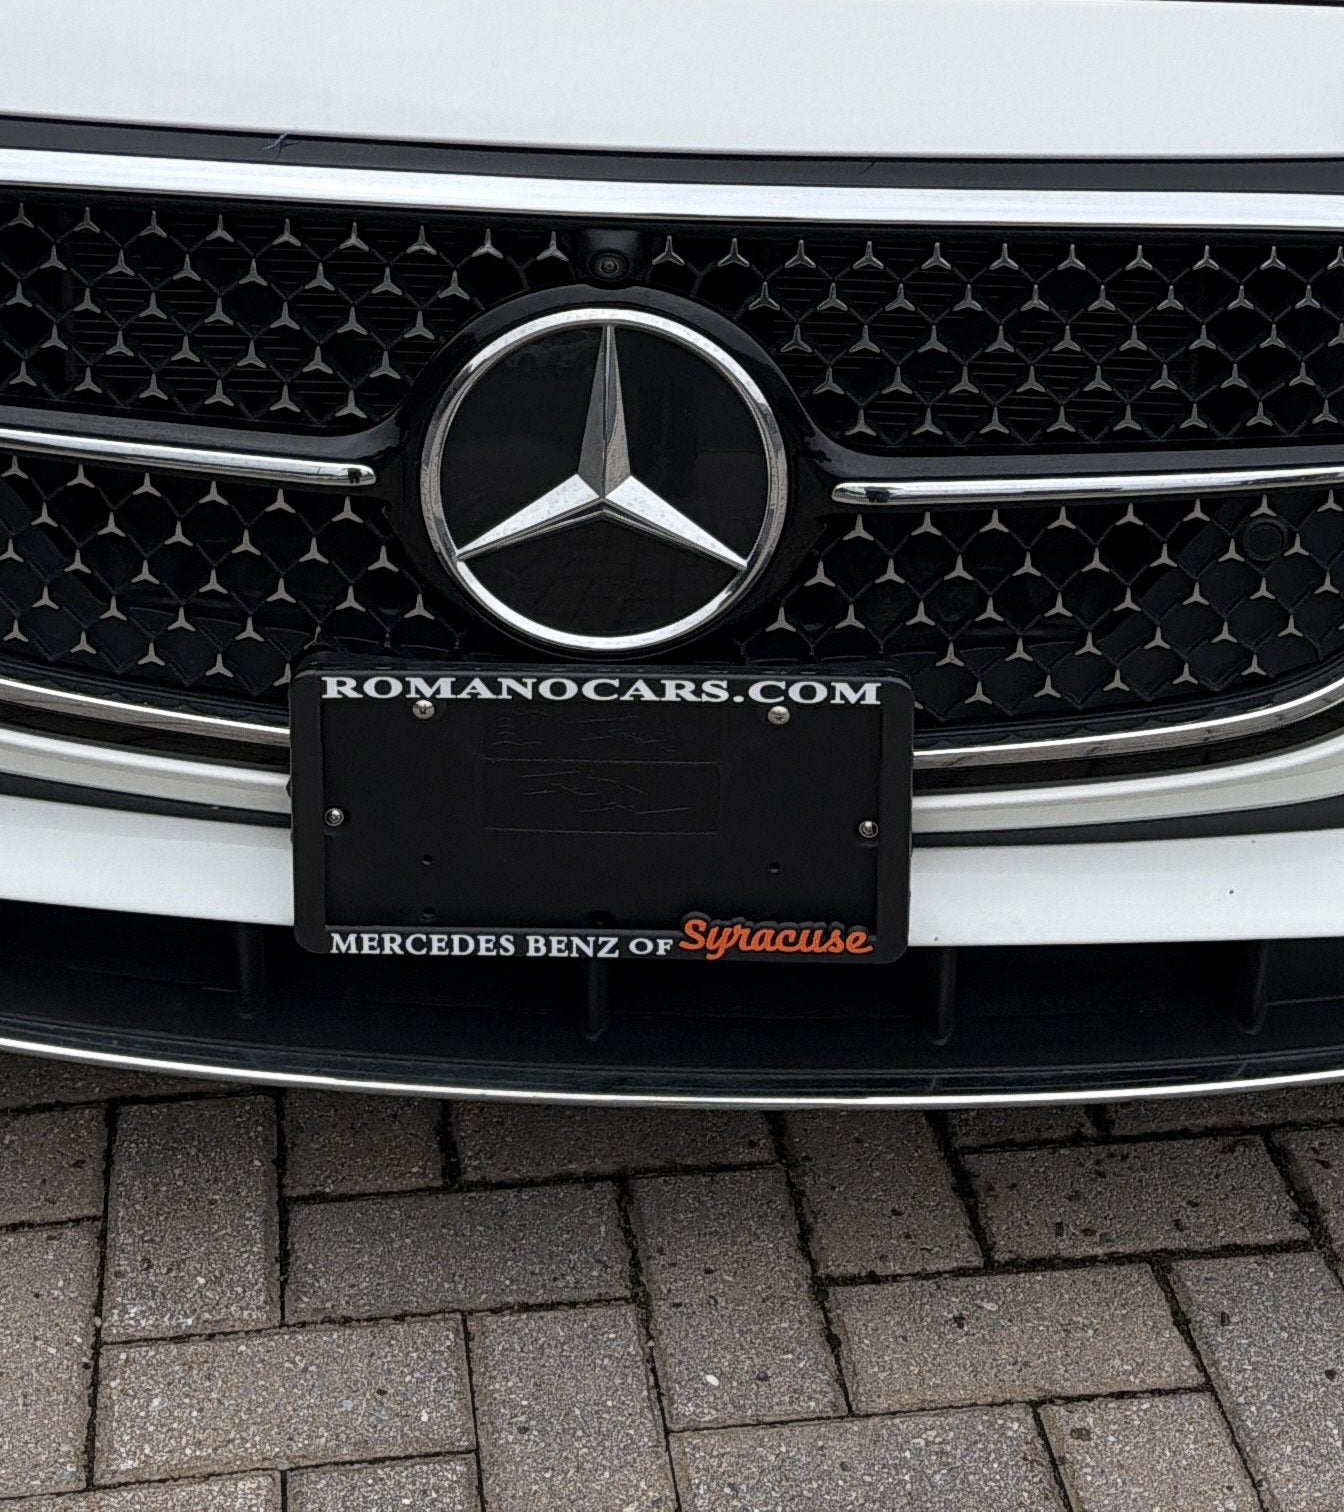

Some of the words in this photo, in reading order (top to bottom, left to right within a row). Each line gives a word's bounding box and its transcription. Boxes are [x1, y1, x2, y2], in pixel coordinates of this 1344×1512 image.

[321, 676, 882, 706] ROMANOCARS.COM
[330, 932, 516, 957] MERCEDES
[525, 935, 620, 959] BENZ
[629, 937, 674, 957] OF
[679, 919, 874, 961] Syracuse
